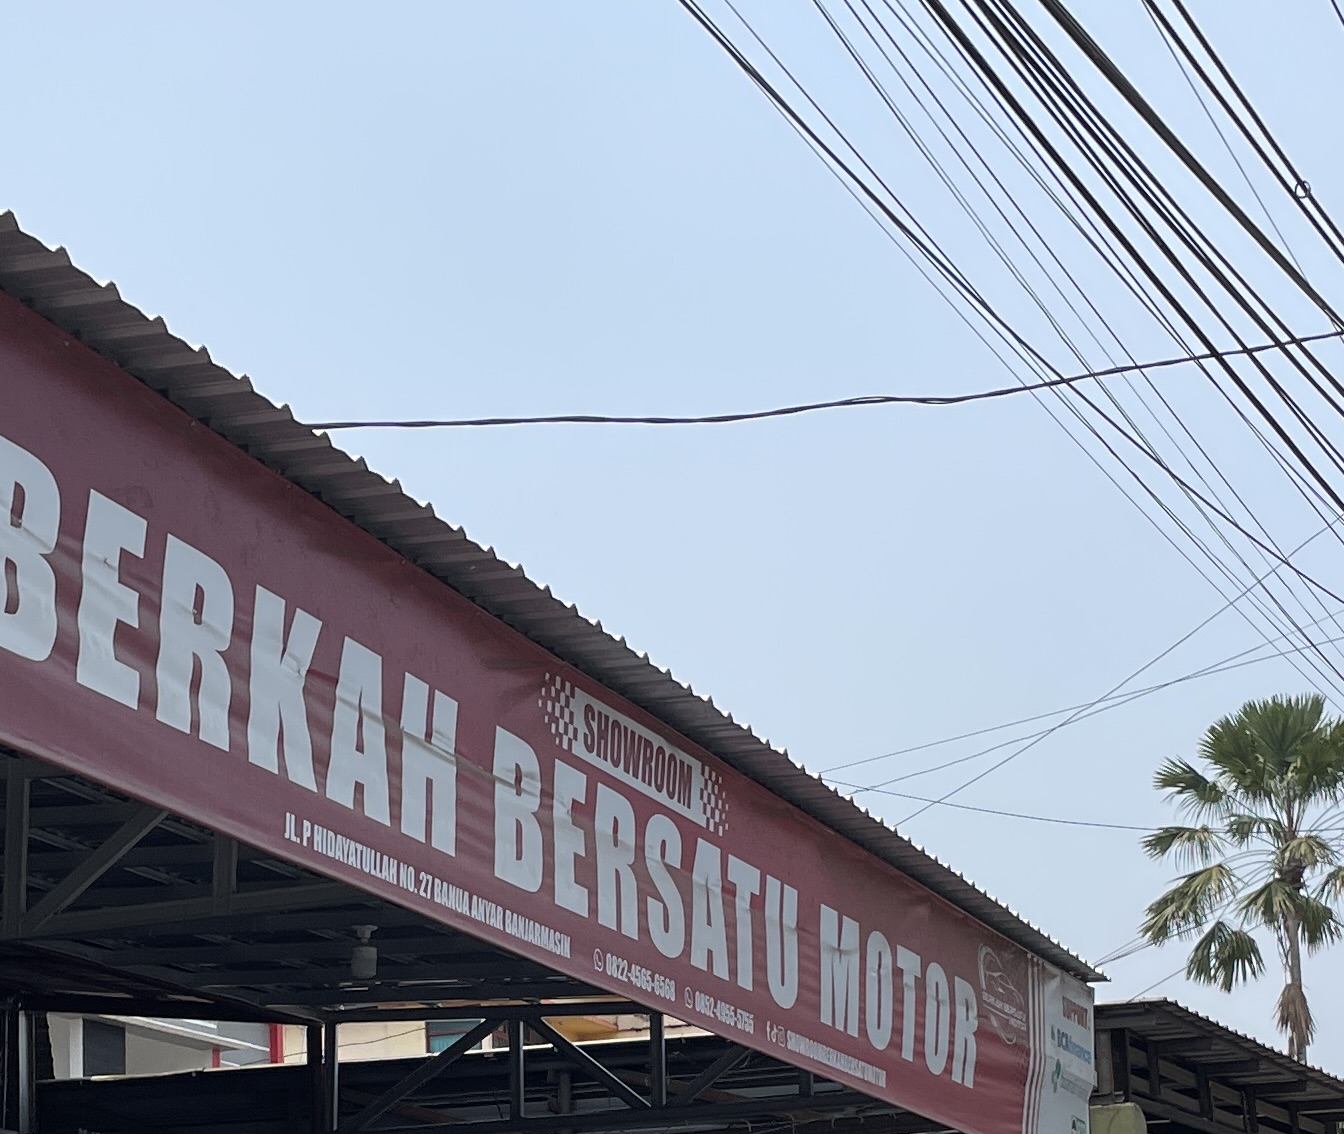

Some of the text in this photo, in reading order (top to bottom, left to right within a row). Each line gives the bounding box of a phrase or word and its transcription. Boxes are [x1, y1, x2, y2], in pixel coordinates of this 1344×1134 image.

[583, 703, 693, 809] SHOWROOM
[284, 811, 571, 959] JL. P HIDAYATULLAH NO. 27 BANUA ANYAR BANJARMASIN
[494, 725, 798, 1009] BERSATU
[820, 903, 979, 1089] MOTOR
